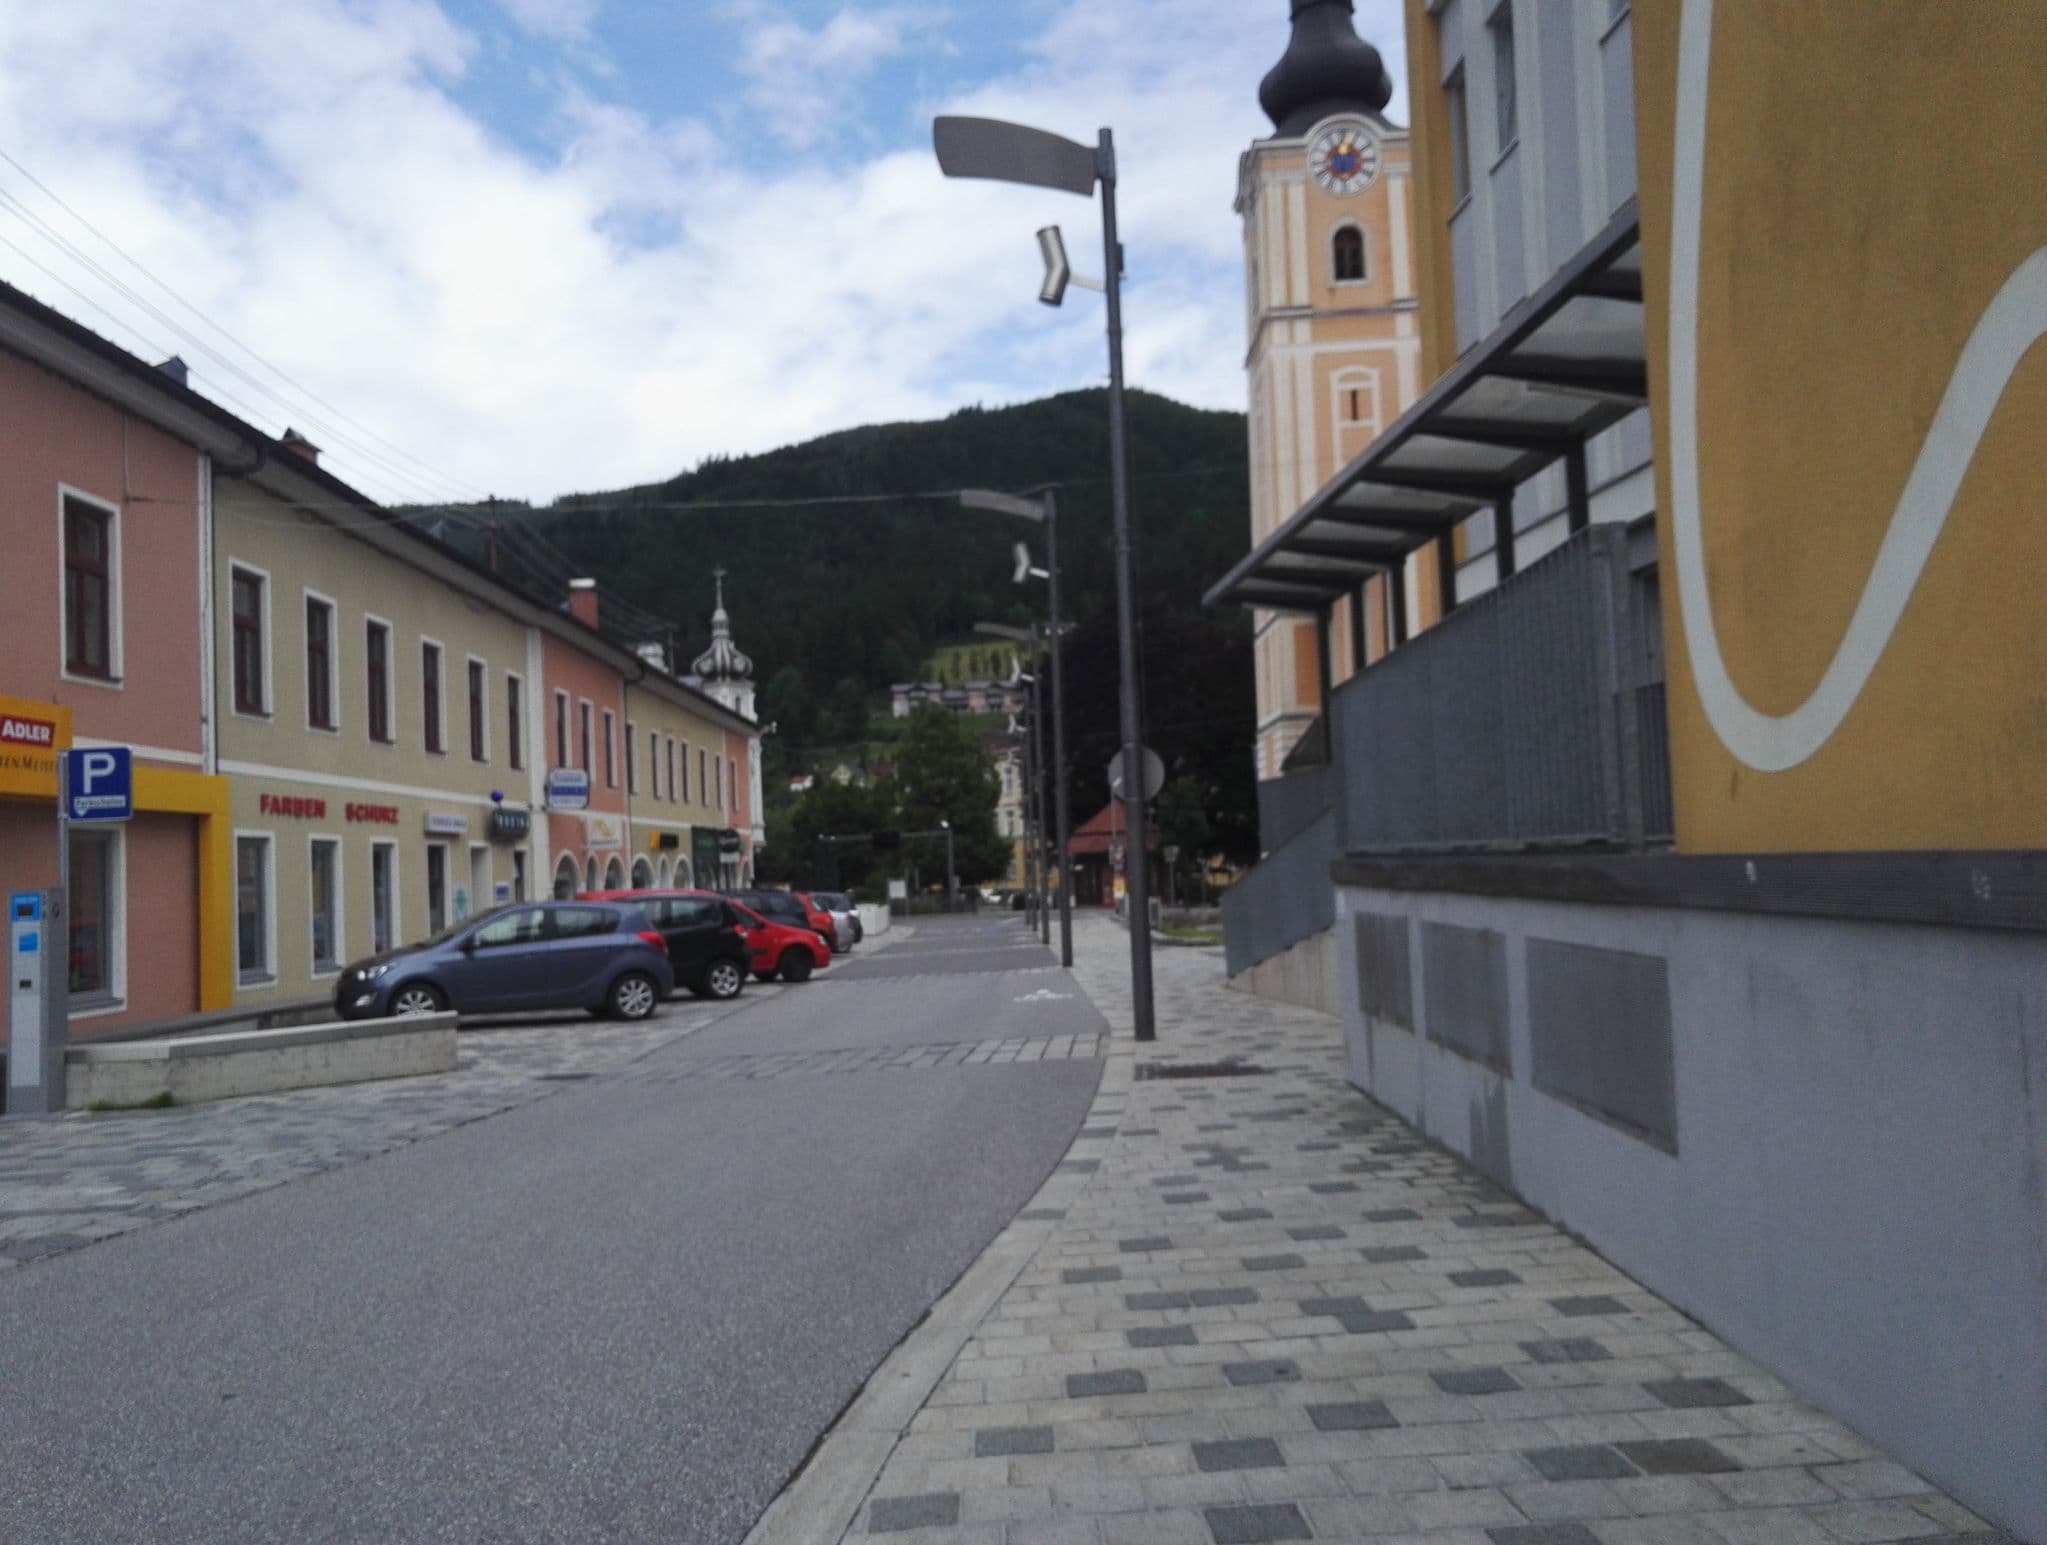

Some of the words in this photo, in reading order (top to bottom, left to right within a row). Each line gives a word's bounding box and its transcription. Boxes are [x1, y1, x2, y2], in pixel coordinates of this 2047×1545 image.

[2, 719, 50, 741] ADLER
[83, 752, 115, 794] P
[259, 794, 326, 819] FARBEN
